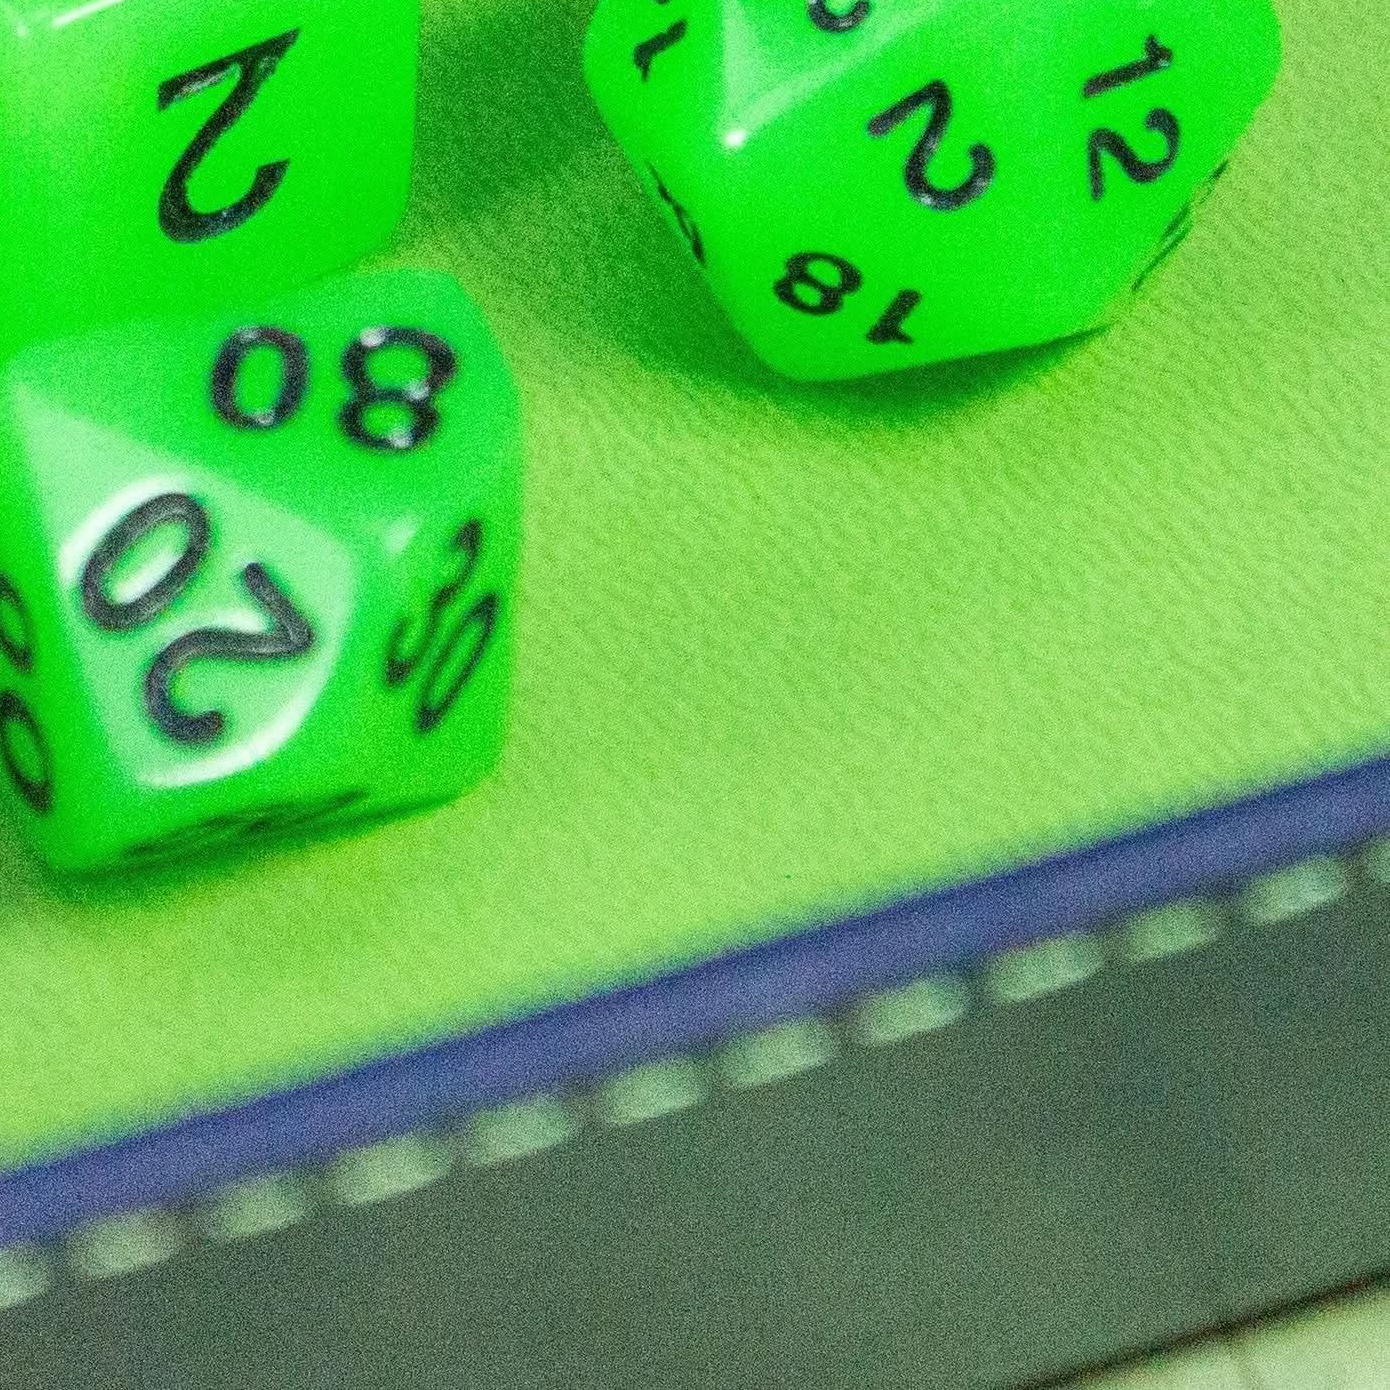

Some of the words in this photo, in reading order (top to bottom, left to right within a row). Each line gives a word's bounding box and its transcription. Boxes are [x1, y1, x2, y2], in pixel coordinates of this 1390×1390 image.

[158, 30, 298, 243] 2
[867, 79, 995, 211] 2
[1082, 35, 1181, 200] 12
[773, 252, 921, 345] 18
[210, 326, 458, 451] 80
[79, 492, 316, 748] 20
